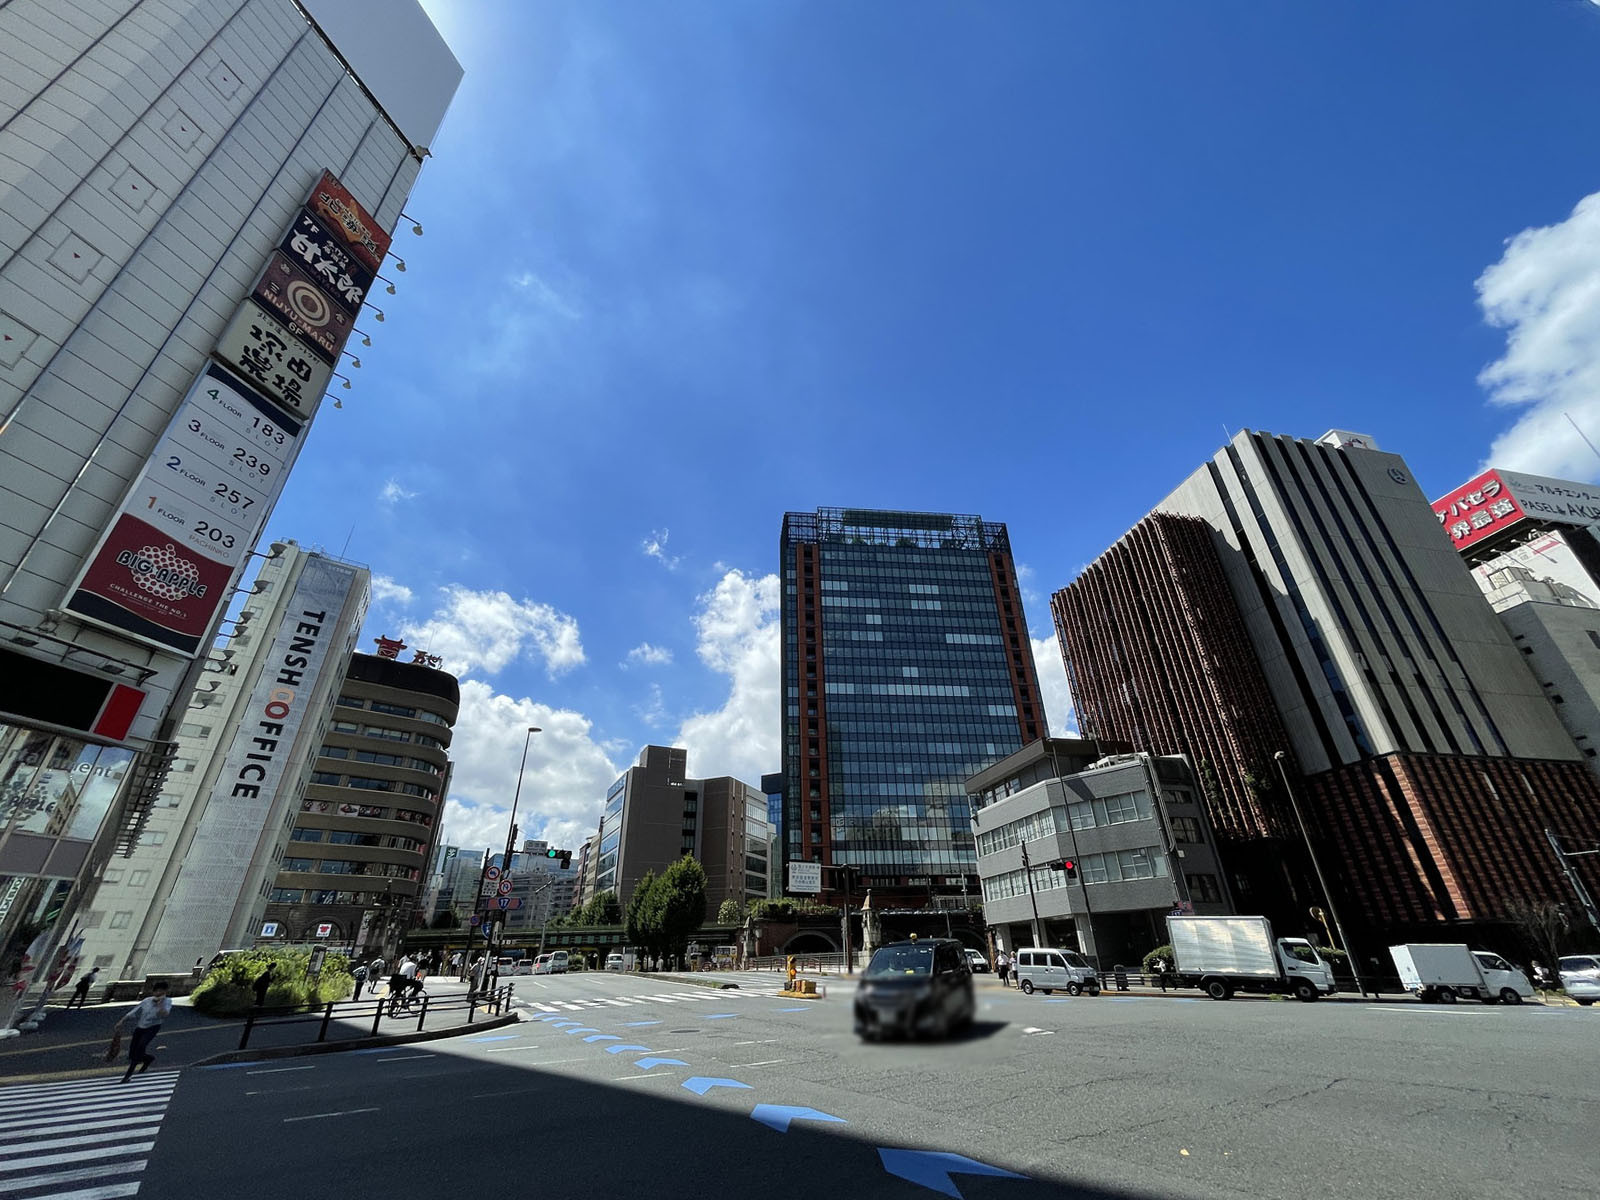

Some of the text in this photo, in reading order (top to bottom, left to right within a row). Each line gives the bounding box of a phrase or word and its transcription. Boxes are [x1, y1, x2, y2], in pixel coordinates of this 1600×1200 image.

[303, 215, 319, 233] 7F
[290, 228, 362, 303] 甘太郎
[263, 289, 333, 350] NIJYU-MARU
[288, 321, 304, 334] 6F
[206, 389, 284, 444] 4 FLOOR 183
[187, 419, 270, 475] 3 FLOOR 239
[166, 455, 254, 509] 2 FLOOR 257
[147, 496, 235, 548] 1 FLOOR 203
[116, 549, 207, 598] BIG APPLE
[231, 701, 290, 799] OFFICE
[500, 898, 509, 906] 17
